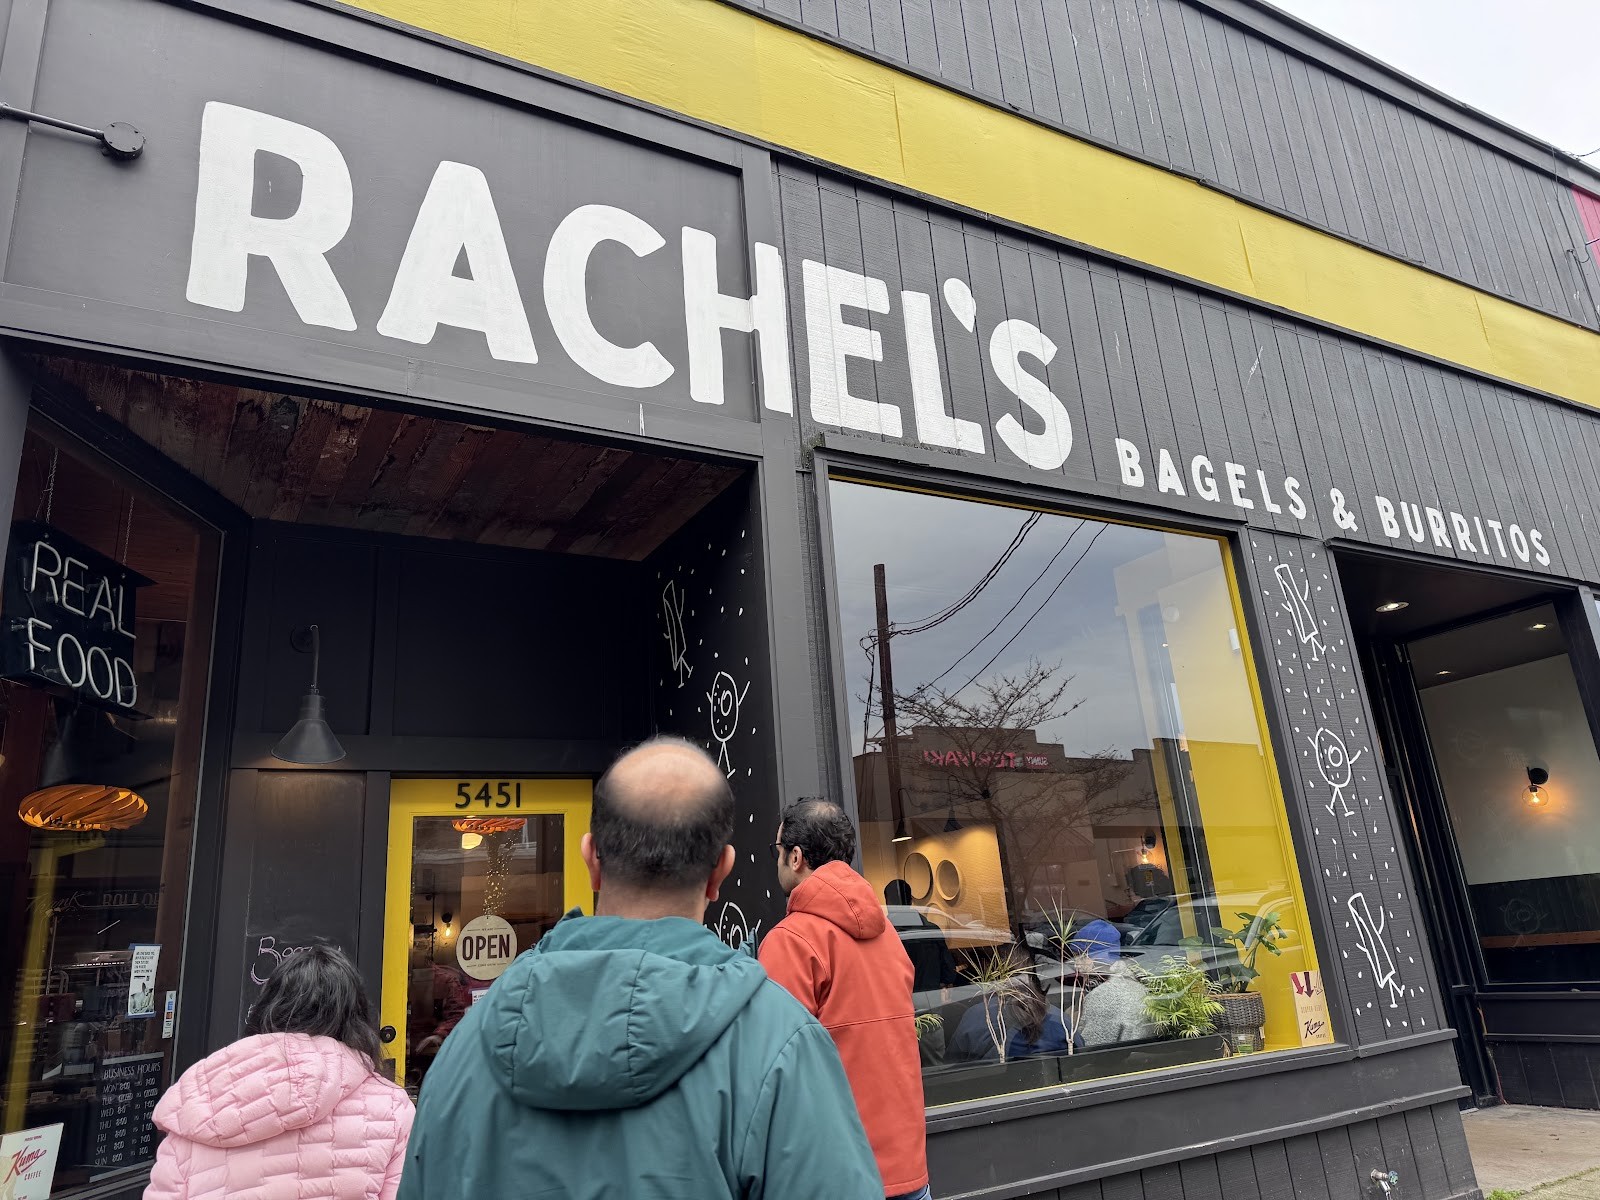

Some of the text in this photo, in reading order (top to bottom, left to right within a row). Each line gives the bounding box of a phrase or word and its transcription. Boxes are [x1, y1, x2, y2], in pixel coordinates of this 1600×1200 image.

[186, 101, 1073, 471] RACHEL'S
[1115, 437, 1550, 567] BAGELS & BURRITOS
[30, 540, 137, 640] REAL
[27, 617, 138, 708] FOOD
[455, 782, 521, 808] 5451
[462, 934, 510, 961] OPEN
[103, 1062, 161, 1080] BUSINESS HOURS
[103, 1084, 117, 1093] MON
[102, 1097, 112, 1106] TUE
[101, 1108, 114, 1118] WED
[100, 1120, 111, 1130] THU
[97, 1133, 107, 1143] FRI
[96, 1145, 107, 1155] SAT
[3, 1145, 47, 1184] Kuma
[95, 1157, 107, 1166] SUN
[24, 1170, 42, 1181] COFFEE
